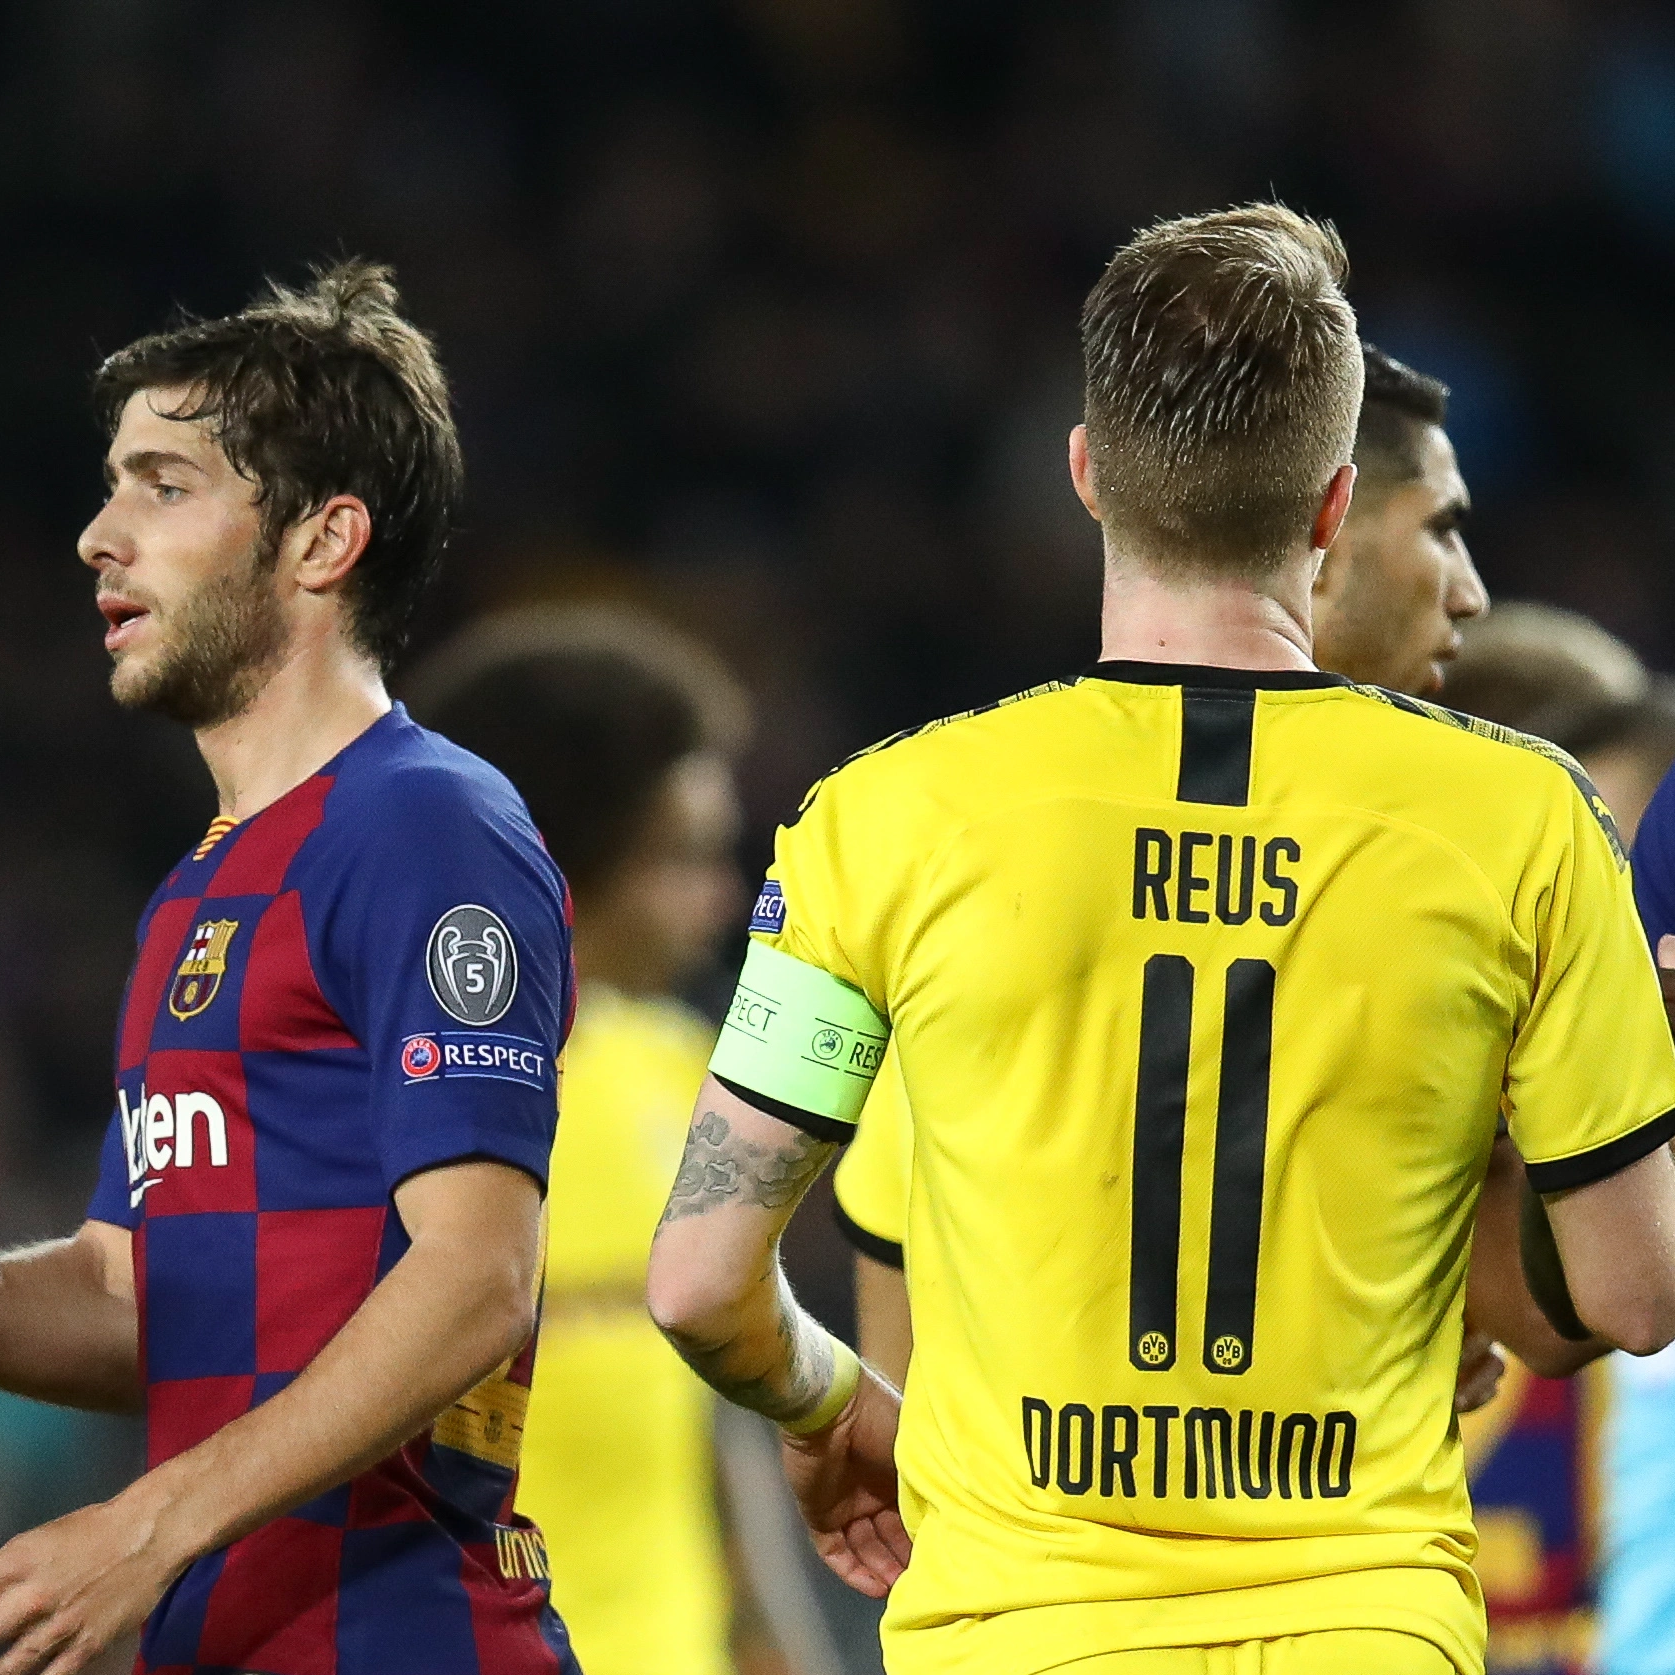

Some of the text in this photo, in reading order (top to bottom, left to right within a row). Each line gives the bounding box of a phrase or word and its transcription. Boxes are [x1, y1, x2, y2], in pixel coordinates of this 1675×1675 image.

[1132, 827, 1301, 927] REUS
[465, 963, 485, 994] 5
[444, 1044, 545, 1077] RESPECT
[1128, 954, 1276, 1375] 11
[1142, 1334, 1166, 1355] BVB
[1215, 1338, 1241, 1360] BVB
[1022, 1397, 1357, 1500] DORTMUND
